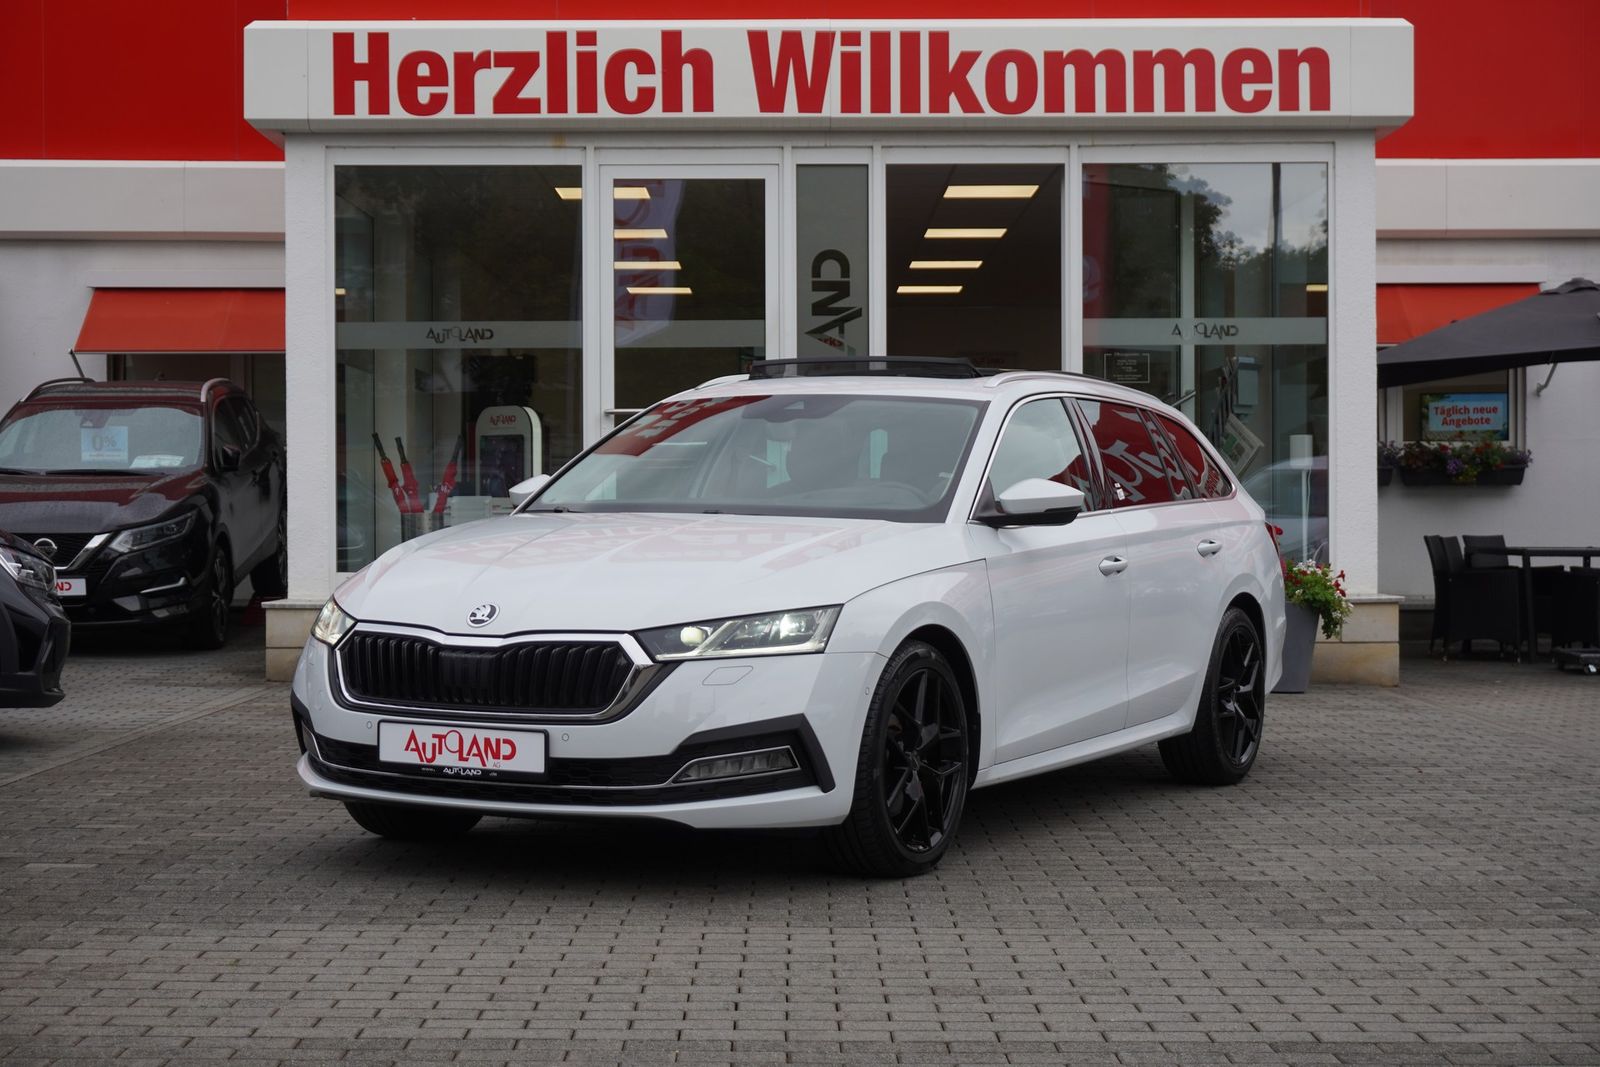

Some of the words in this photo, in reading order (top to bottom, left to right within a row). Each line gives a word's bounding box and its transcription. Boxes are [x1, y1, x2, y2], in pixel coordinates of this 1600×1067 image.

[332, 29, 715, 117] Herzlich
[746, 29, 1332, 115] Willkommen
[803, 249, 863, 357] AND
[426, 326, 494, 344] AUTOLAND
[1171, 322, 1240, 341] AOLAND
[1434, 404, 1471, 417] Täglich
[1473, 406, 1499, 414] neue
[1441, 416, 1492, 428] Angebote
[55, 581, 73, 592] ND
[404, 728, 517, 767] AUTOLAND
[443, 767, 482, 776] AUTOLAND
